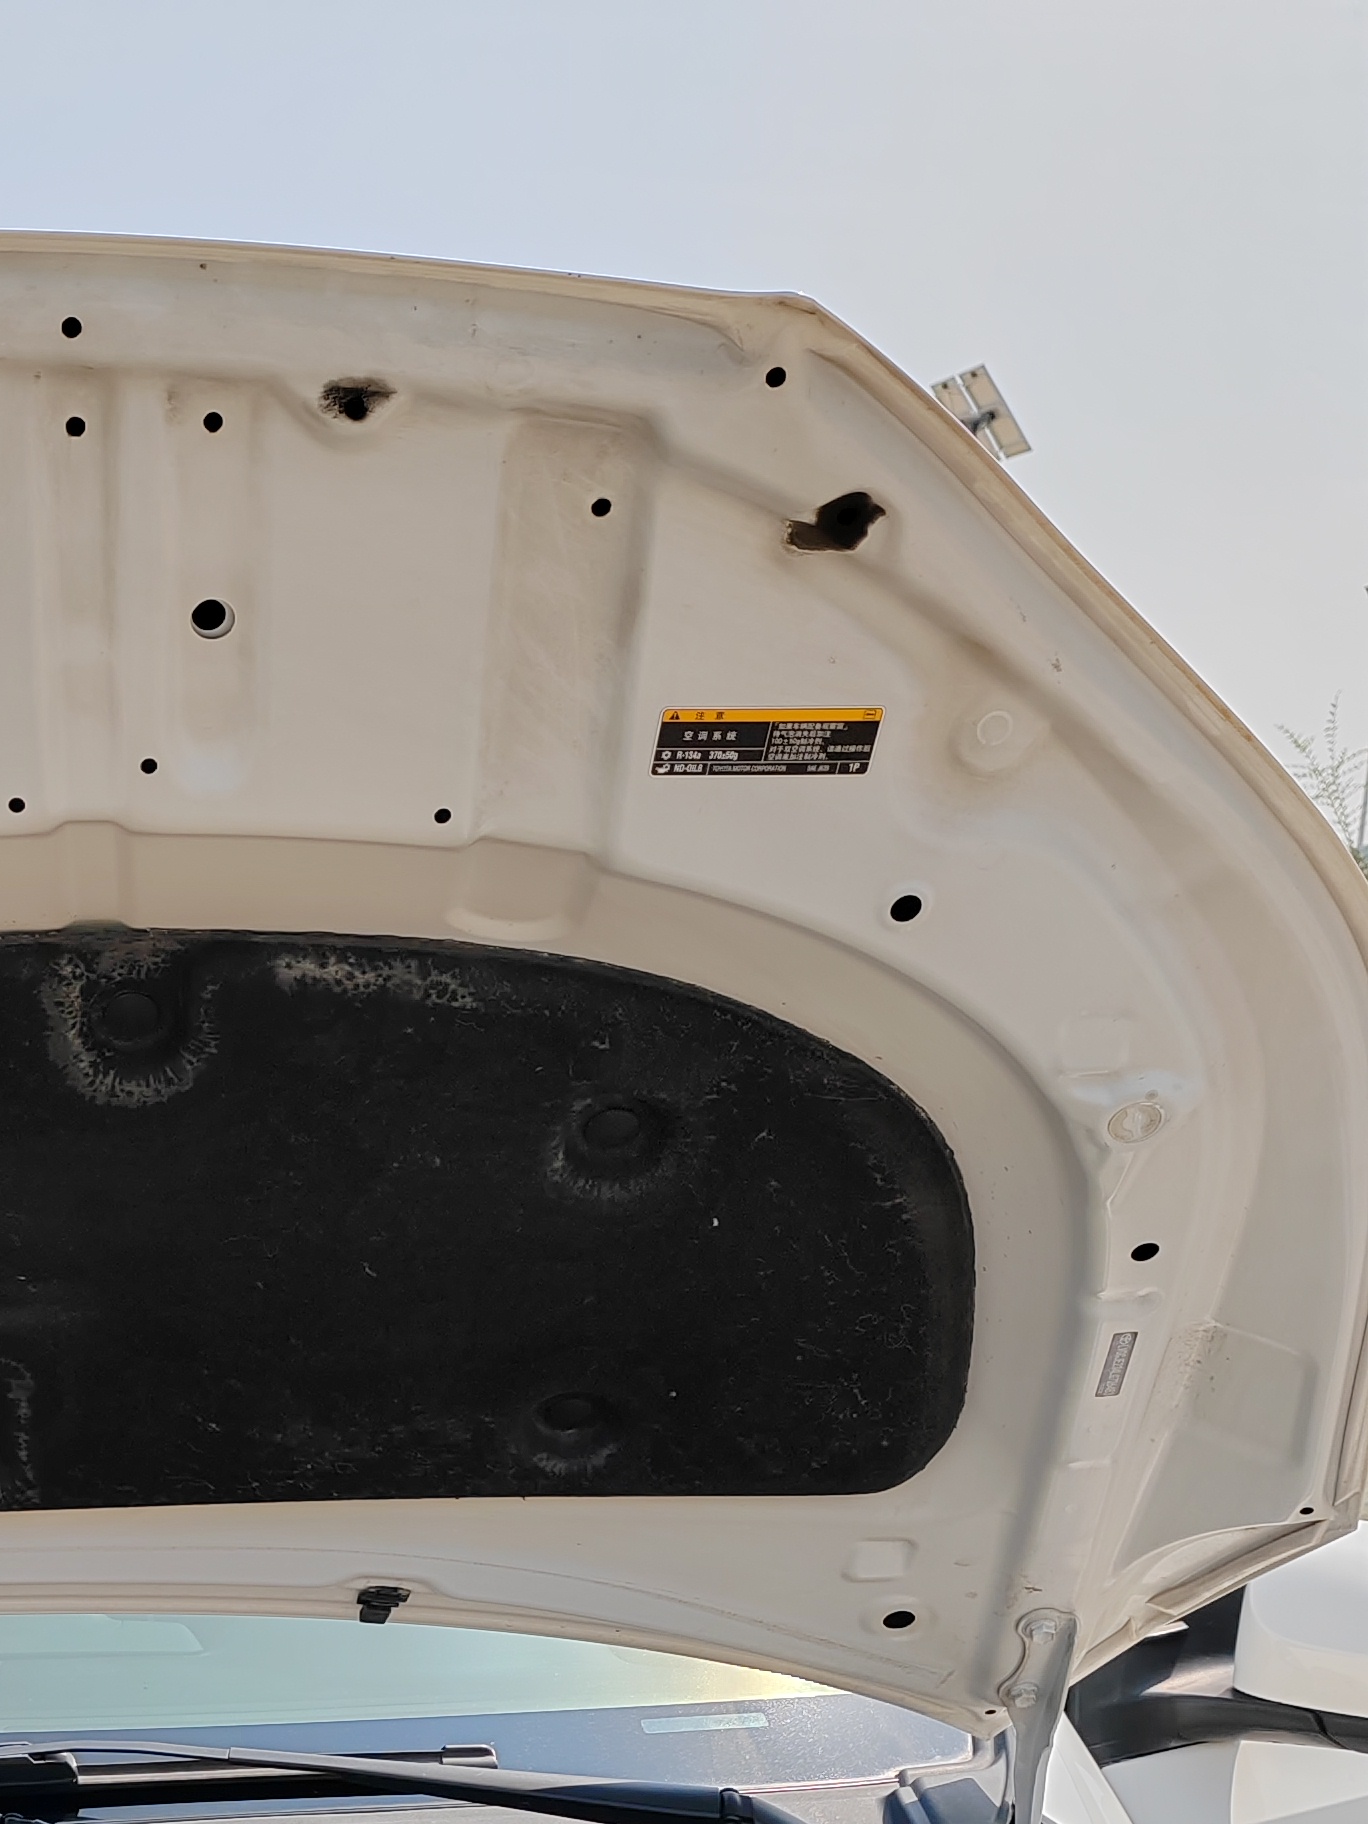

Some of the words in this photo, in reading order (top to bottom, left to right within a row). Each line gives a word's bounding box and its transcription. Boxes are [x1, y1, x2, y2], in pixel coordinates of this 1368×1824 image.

[682, 731, 738, 741] 空调系统
[848, 762, 861, 773] 1P
